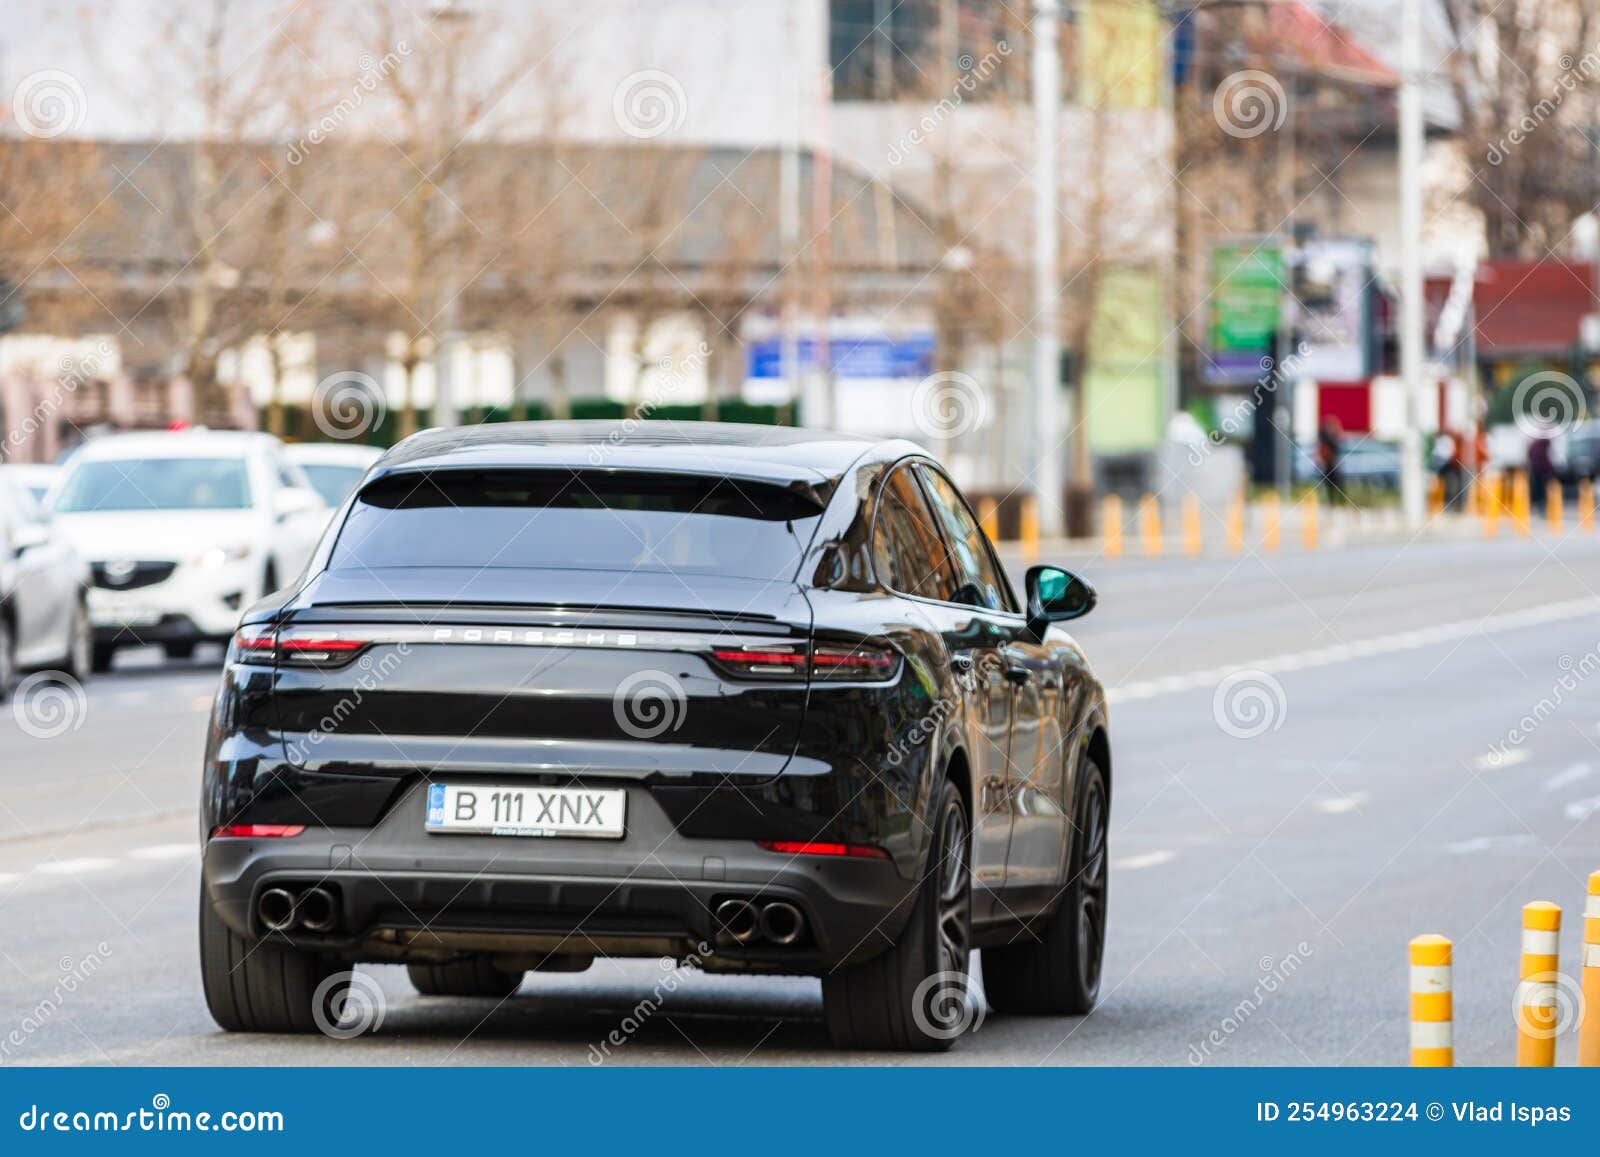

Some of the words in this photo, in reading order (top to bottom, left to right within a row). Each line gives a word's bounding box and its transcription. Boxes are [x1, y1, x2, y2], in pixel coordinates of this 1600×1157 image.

[433, 629, 637, 646] PORSCHE
[455, 791, 477, 821] B
[491, 792, 524, 822] 111
[536, 793, 605, 825] XNX
